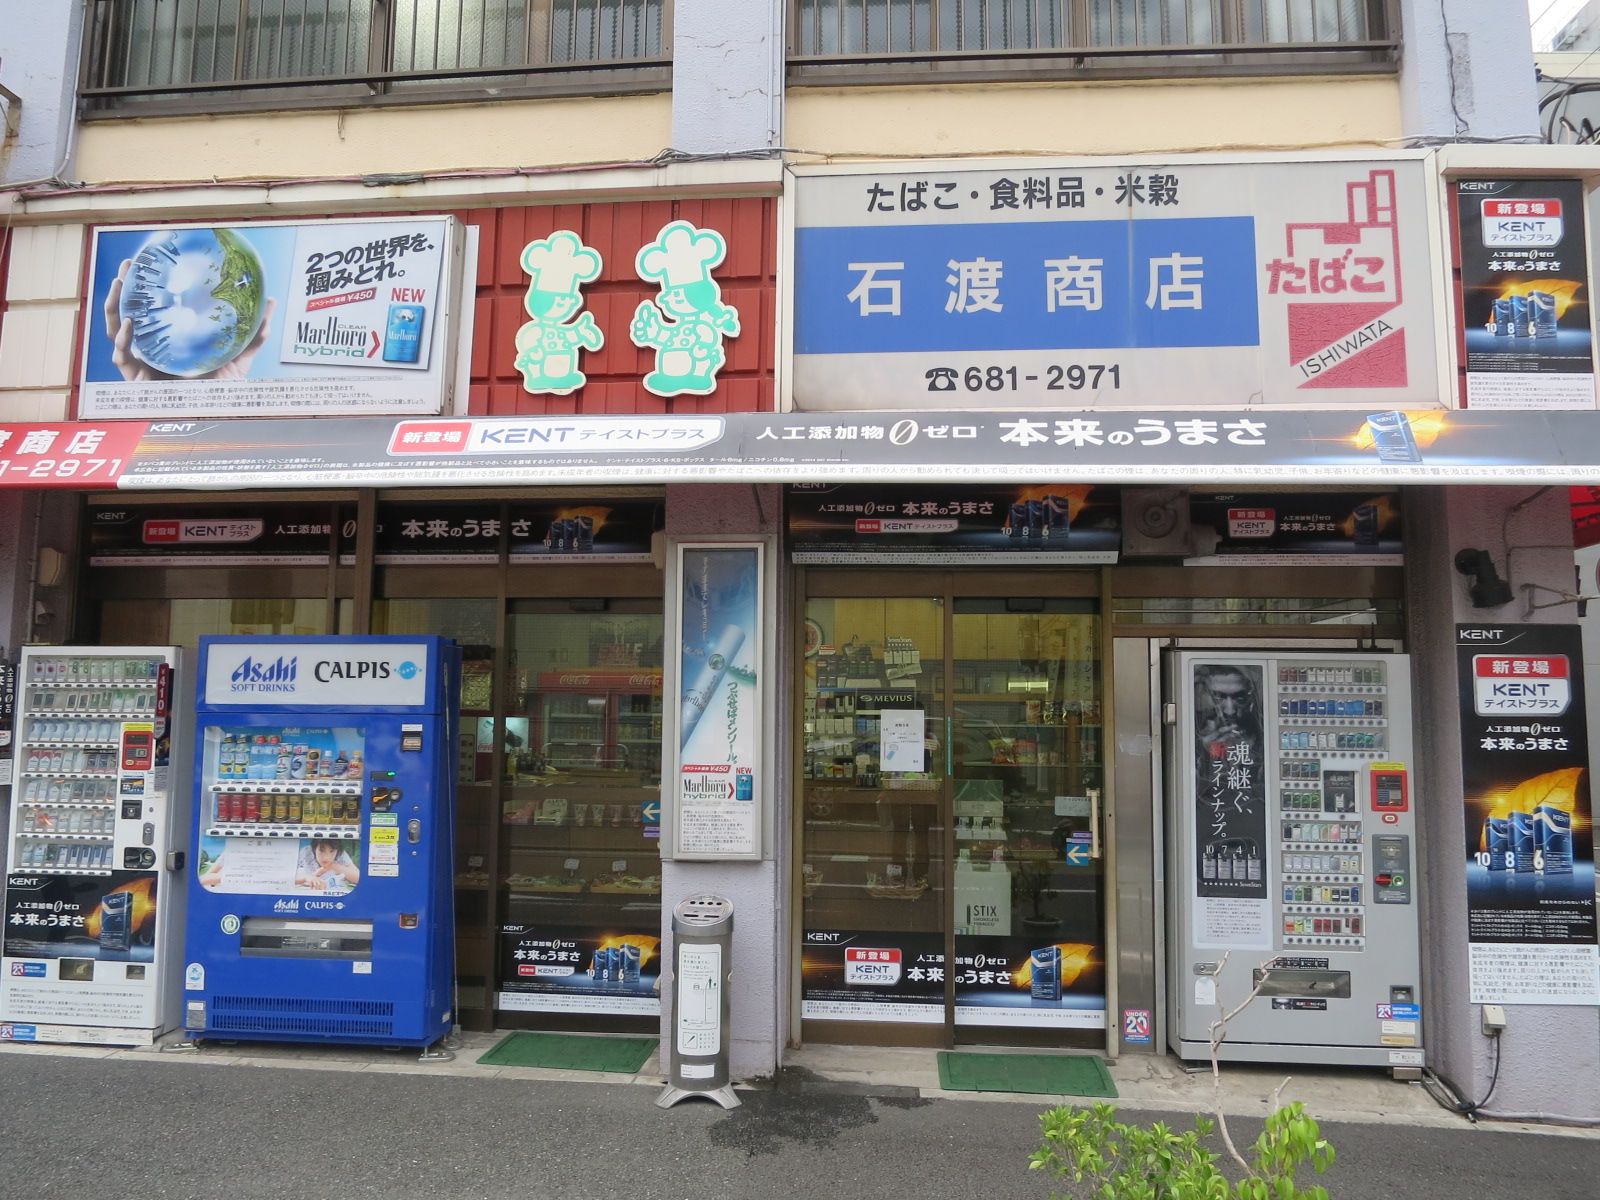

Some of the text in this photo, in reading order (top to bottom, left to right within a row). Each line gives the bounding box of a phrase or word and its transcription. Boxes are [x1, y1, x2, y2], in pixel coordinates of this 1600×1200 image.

[1459, 182, 1496, 190] KENT
[867, 174, 1179, 212] たばこ・食料品・米穀
[1497, 203, 1546, 214] 新登場
[1498, 221, 1546, 232] KENT
[1491, 233, 1554, 242] テイストプラス
[305, 233, 435, 274] 2つの世界を、
[1265, 248, 1386, 294] たばこ
[1488, 261, 1561, 272] 本来のうまさ
[847, 252, 1204, 316] 石渡商店
[347, 289, 373, 302] ¥450
[391, 287, 426, 303] NEW
[295, 316, 367, 347] Marlboro
[1485, 321, 1536, 335] 10 8 6
[293, 344, 365, 358] hybrid
[1299, 319, 1393, 378] ISHIWATA
[963, 363, 1122, 391] 681-2971
[150, 423, 197, 432] KENT
[999, 418, 1267, 447] 本来のうまさ
[402, 427, 705, 444] 新登場 KENT テイストプラス
[902, 501, 994, 516] 本来のうまさ
[96, 512, 126, 520] KENT
[184, 525, 228, 537] KENT
[884, 522, 913, 530] KENT
[1001, 526, 1050, 537] 10 8 6
[1279, 522, 1336, 531] 本来のうまさ
[543, 537, 579, 548] 10 8 6
[1460, 629, 1503, 639] KENT
[231, 656, 298, 682] Asahi
[314, 660, 390, 682] CALPIS
[1492, 661, 1550, 674] 新登場
[231, 683, 295, 692] SOFT DRINKS
[1493, 683, 1550, 696] KENT
[1484, 699, 1560, 708] テイストプラス
[1480, 737, 1569, 751] 本来のうまさ
[684, 775, 726, 792] Marlboro
[1206, 845, 1214, 854] 10
[1221, 845, 1228, 854] 7
[1236, 845, 1243, 854] 4
[1474, 849, 1544, 870] 10 8 6
[9, 878, 39, 886] KENT
[274, 899, 299, 909] Asahi
[304, 900, 334, 910] CALPIS
[973, 904, 997, 916] STIX
[10, 913, 86, 928] 本来のうまさ
[807, 932, 840, 941] KENT
[513, 949, 581, 962] 本来のうまさ
[856, 951, 890, 961] 新登場
[586, 968, 624, 979] 10 8 6
[856, 965, 890, 973] KENT
[1126, 1016, 1148, 1034] 20
